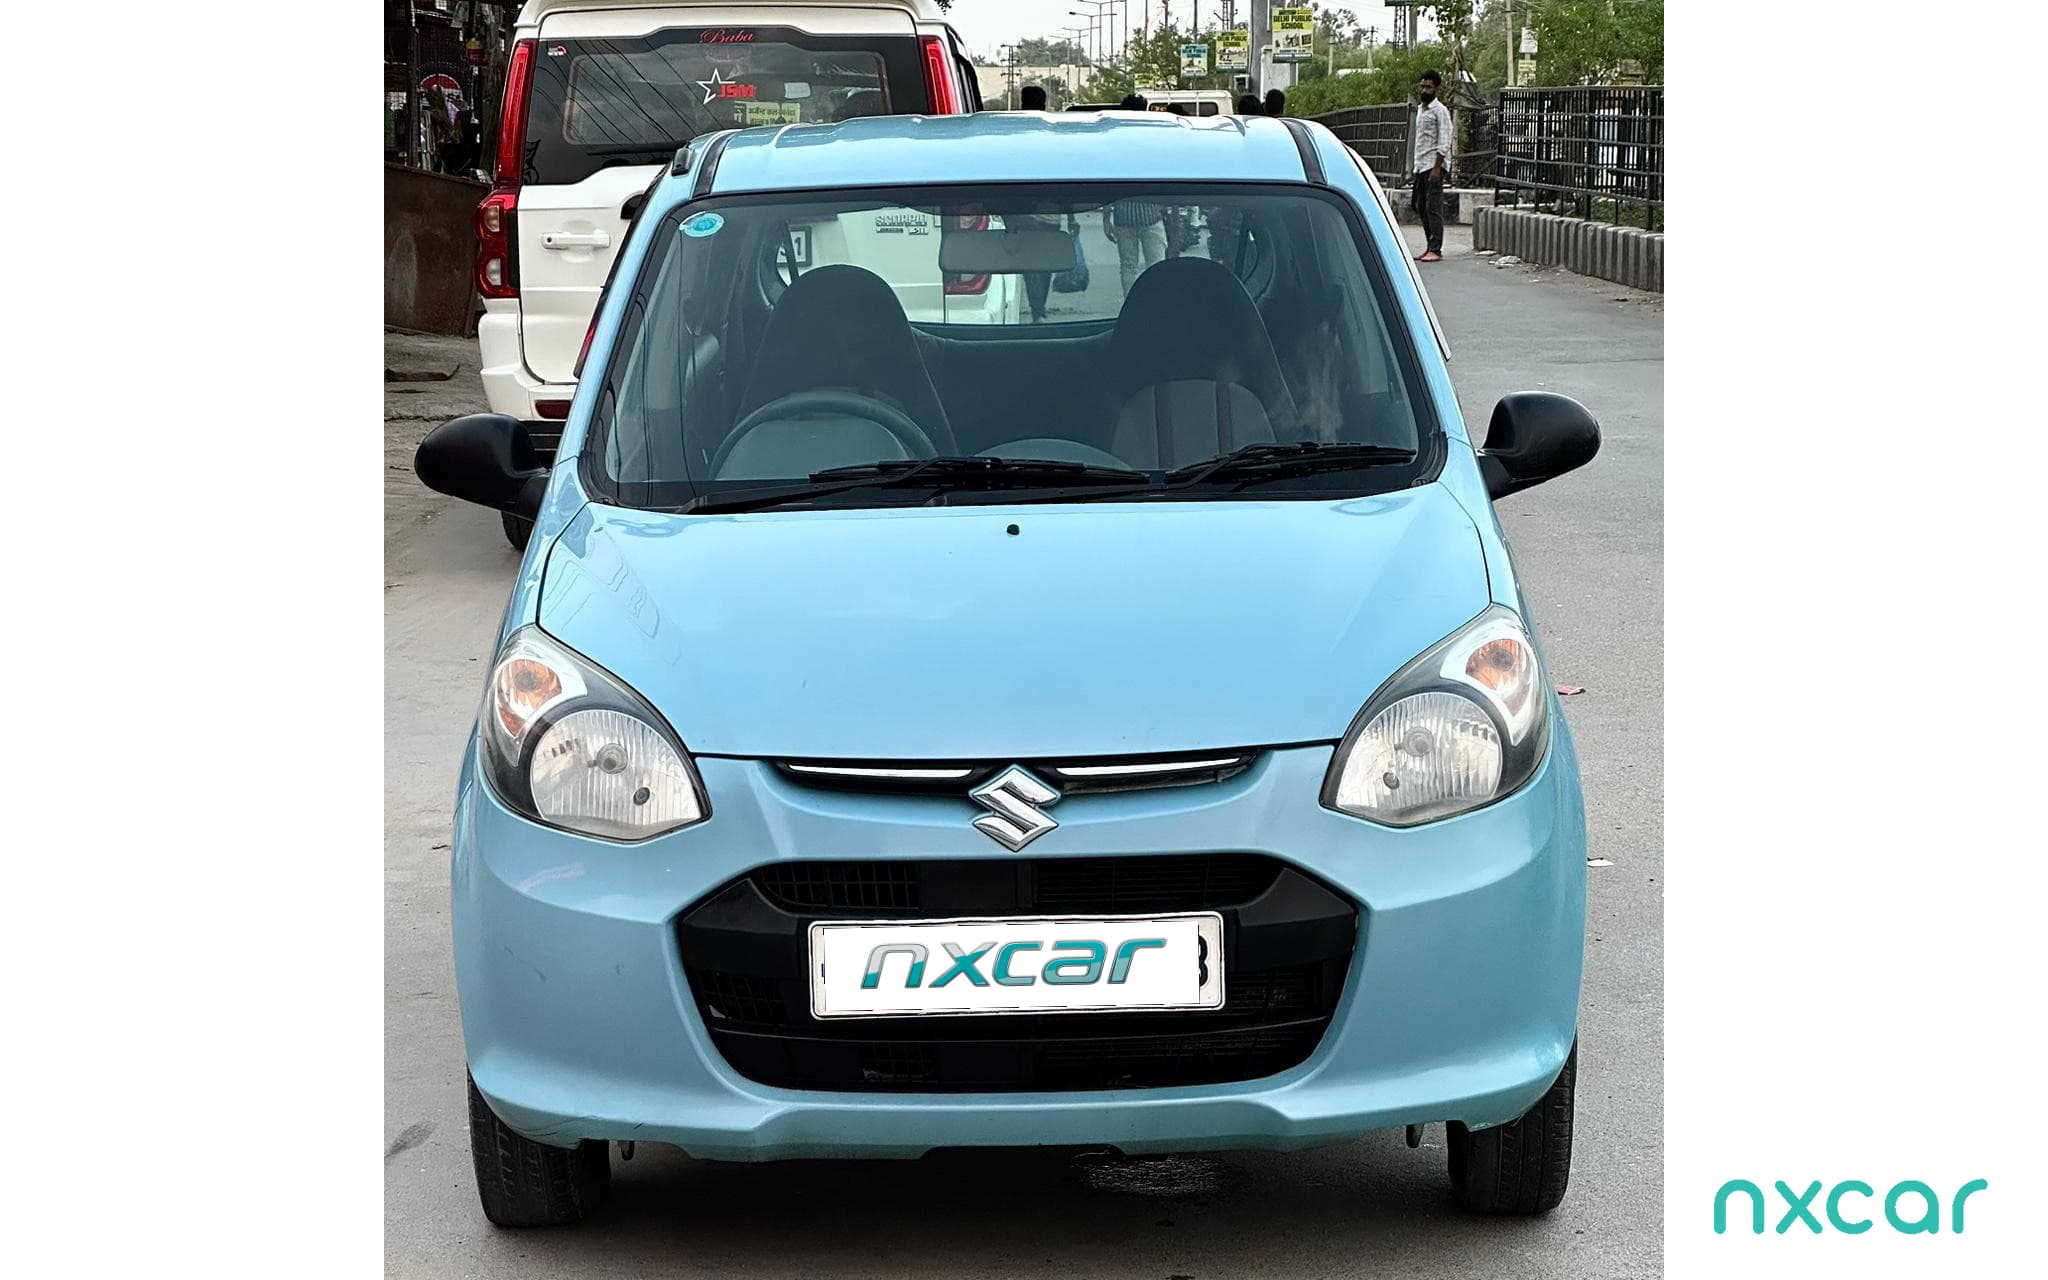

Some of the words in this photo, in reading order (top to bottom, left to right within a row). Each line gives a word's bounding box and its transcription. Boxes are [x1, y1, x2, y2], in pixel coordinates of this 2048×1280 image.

[1273, 15, 1290, 23] DELHI
[1280, 22, 1304, 30] SCHOOL
[700, 29, 754, 44] Baba
